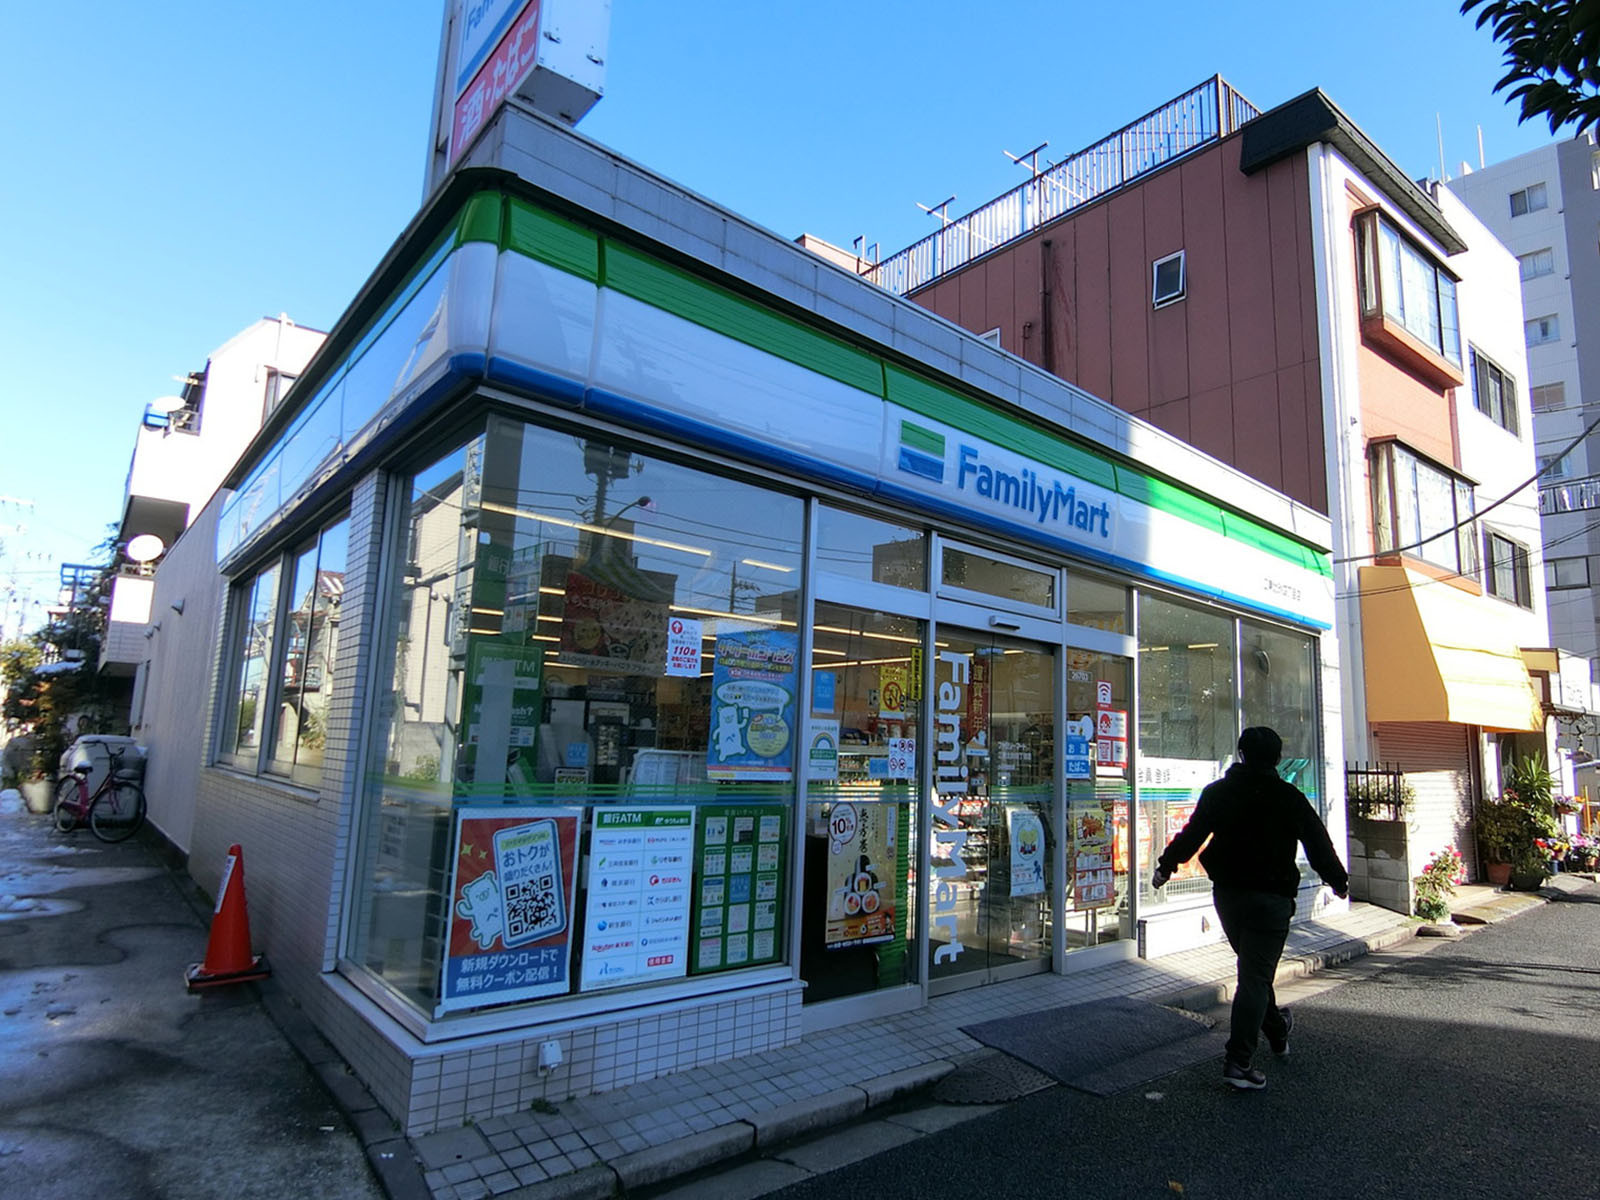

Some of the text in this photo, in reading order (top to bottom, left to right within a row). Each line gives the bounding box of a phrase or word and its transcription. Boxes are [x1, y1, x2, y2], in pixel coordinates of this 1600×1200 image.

[957, 443, 1110, 539] FamilyMart
[602, 813, 642, 824] 銀行ATM
[930, 650, 970, 966] FamilyMart
[503, 844, 550, 867] おトクが
[461, 949, 558, 973] 新規ダウンロードで
[456, 966, 557, 992] 無料クーポン配信！
